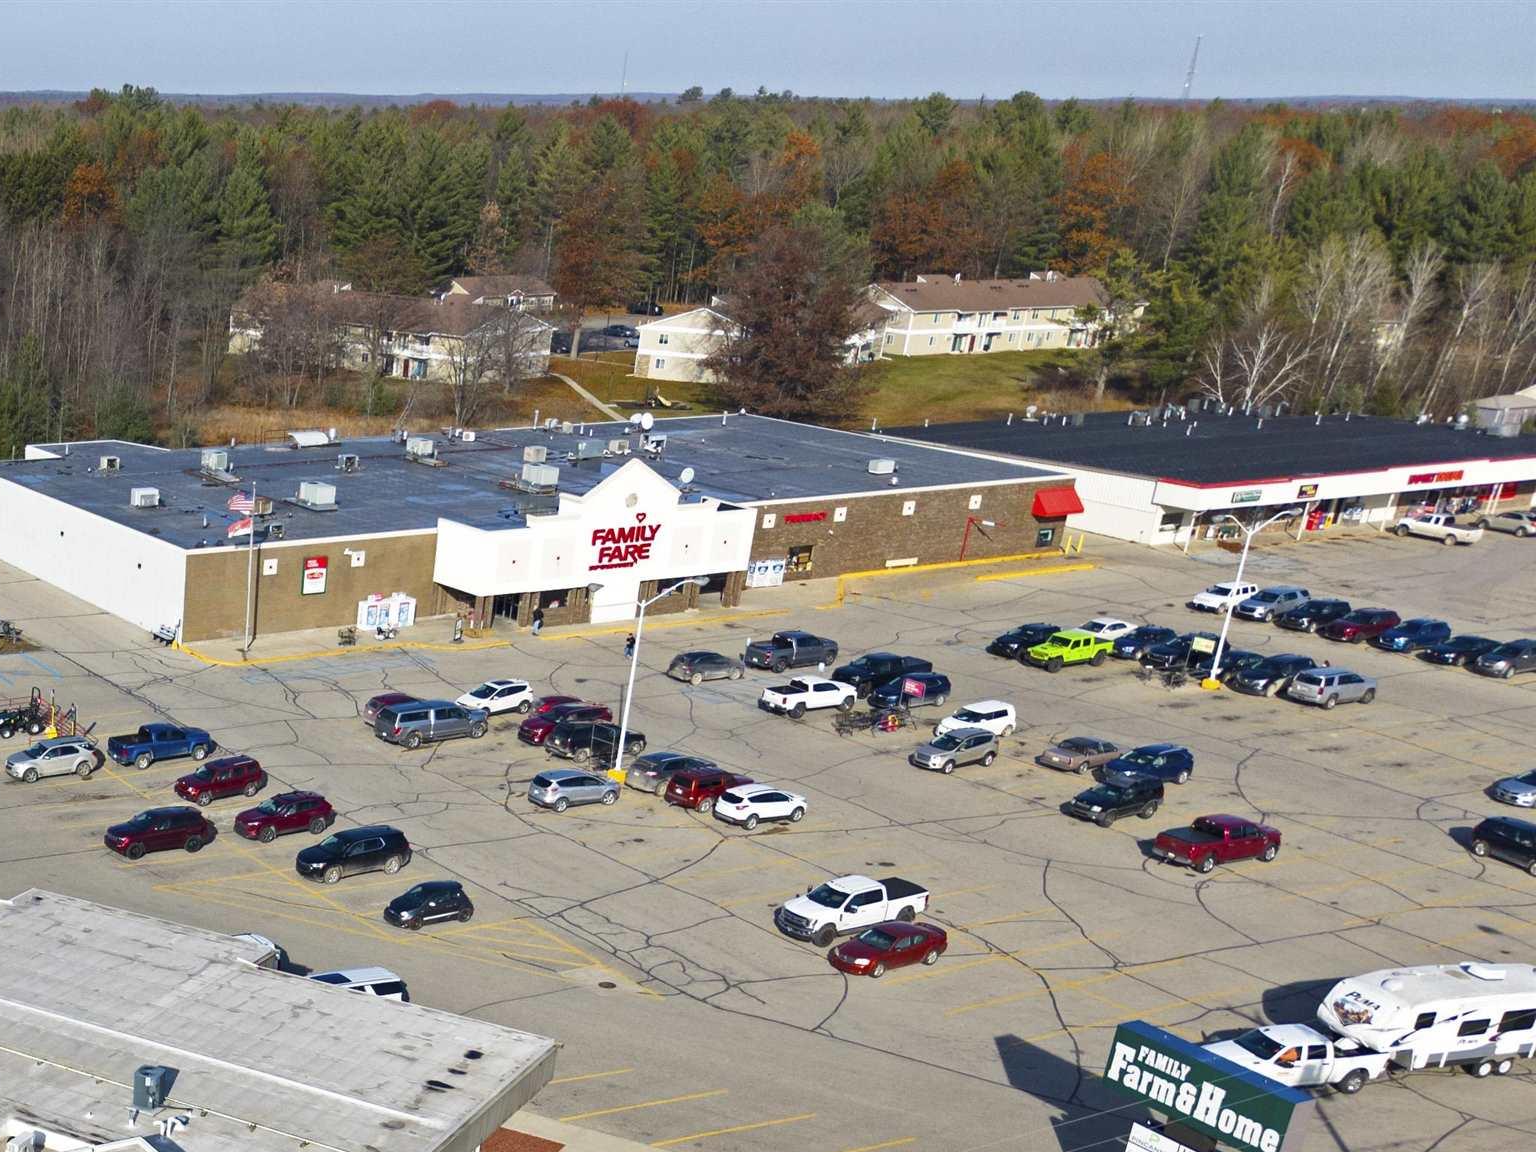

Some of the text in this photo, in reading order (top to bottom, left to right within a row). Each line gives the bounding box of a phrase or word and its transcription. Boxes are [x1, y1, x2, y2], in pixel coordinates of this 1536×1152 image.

[591, 524, 662, 546] FAMILY
[598, 543, 652, 564] FARE
[1137, 1045, 1192, 1082] FAMILY
